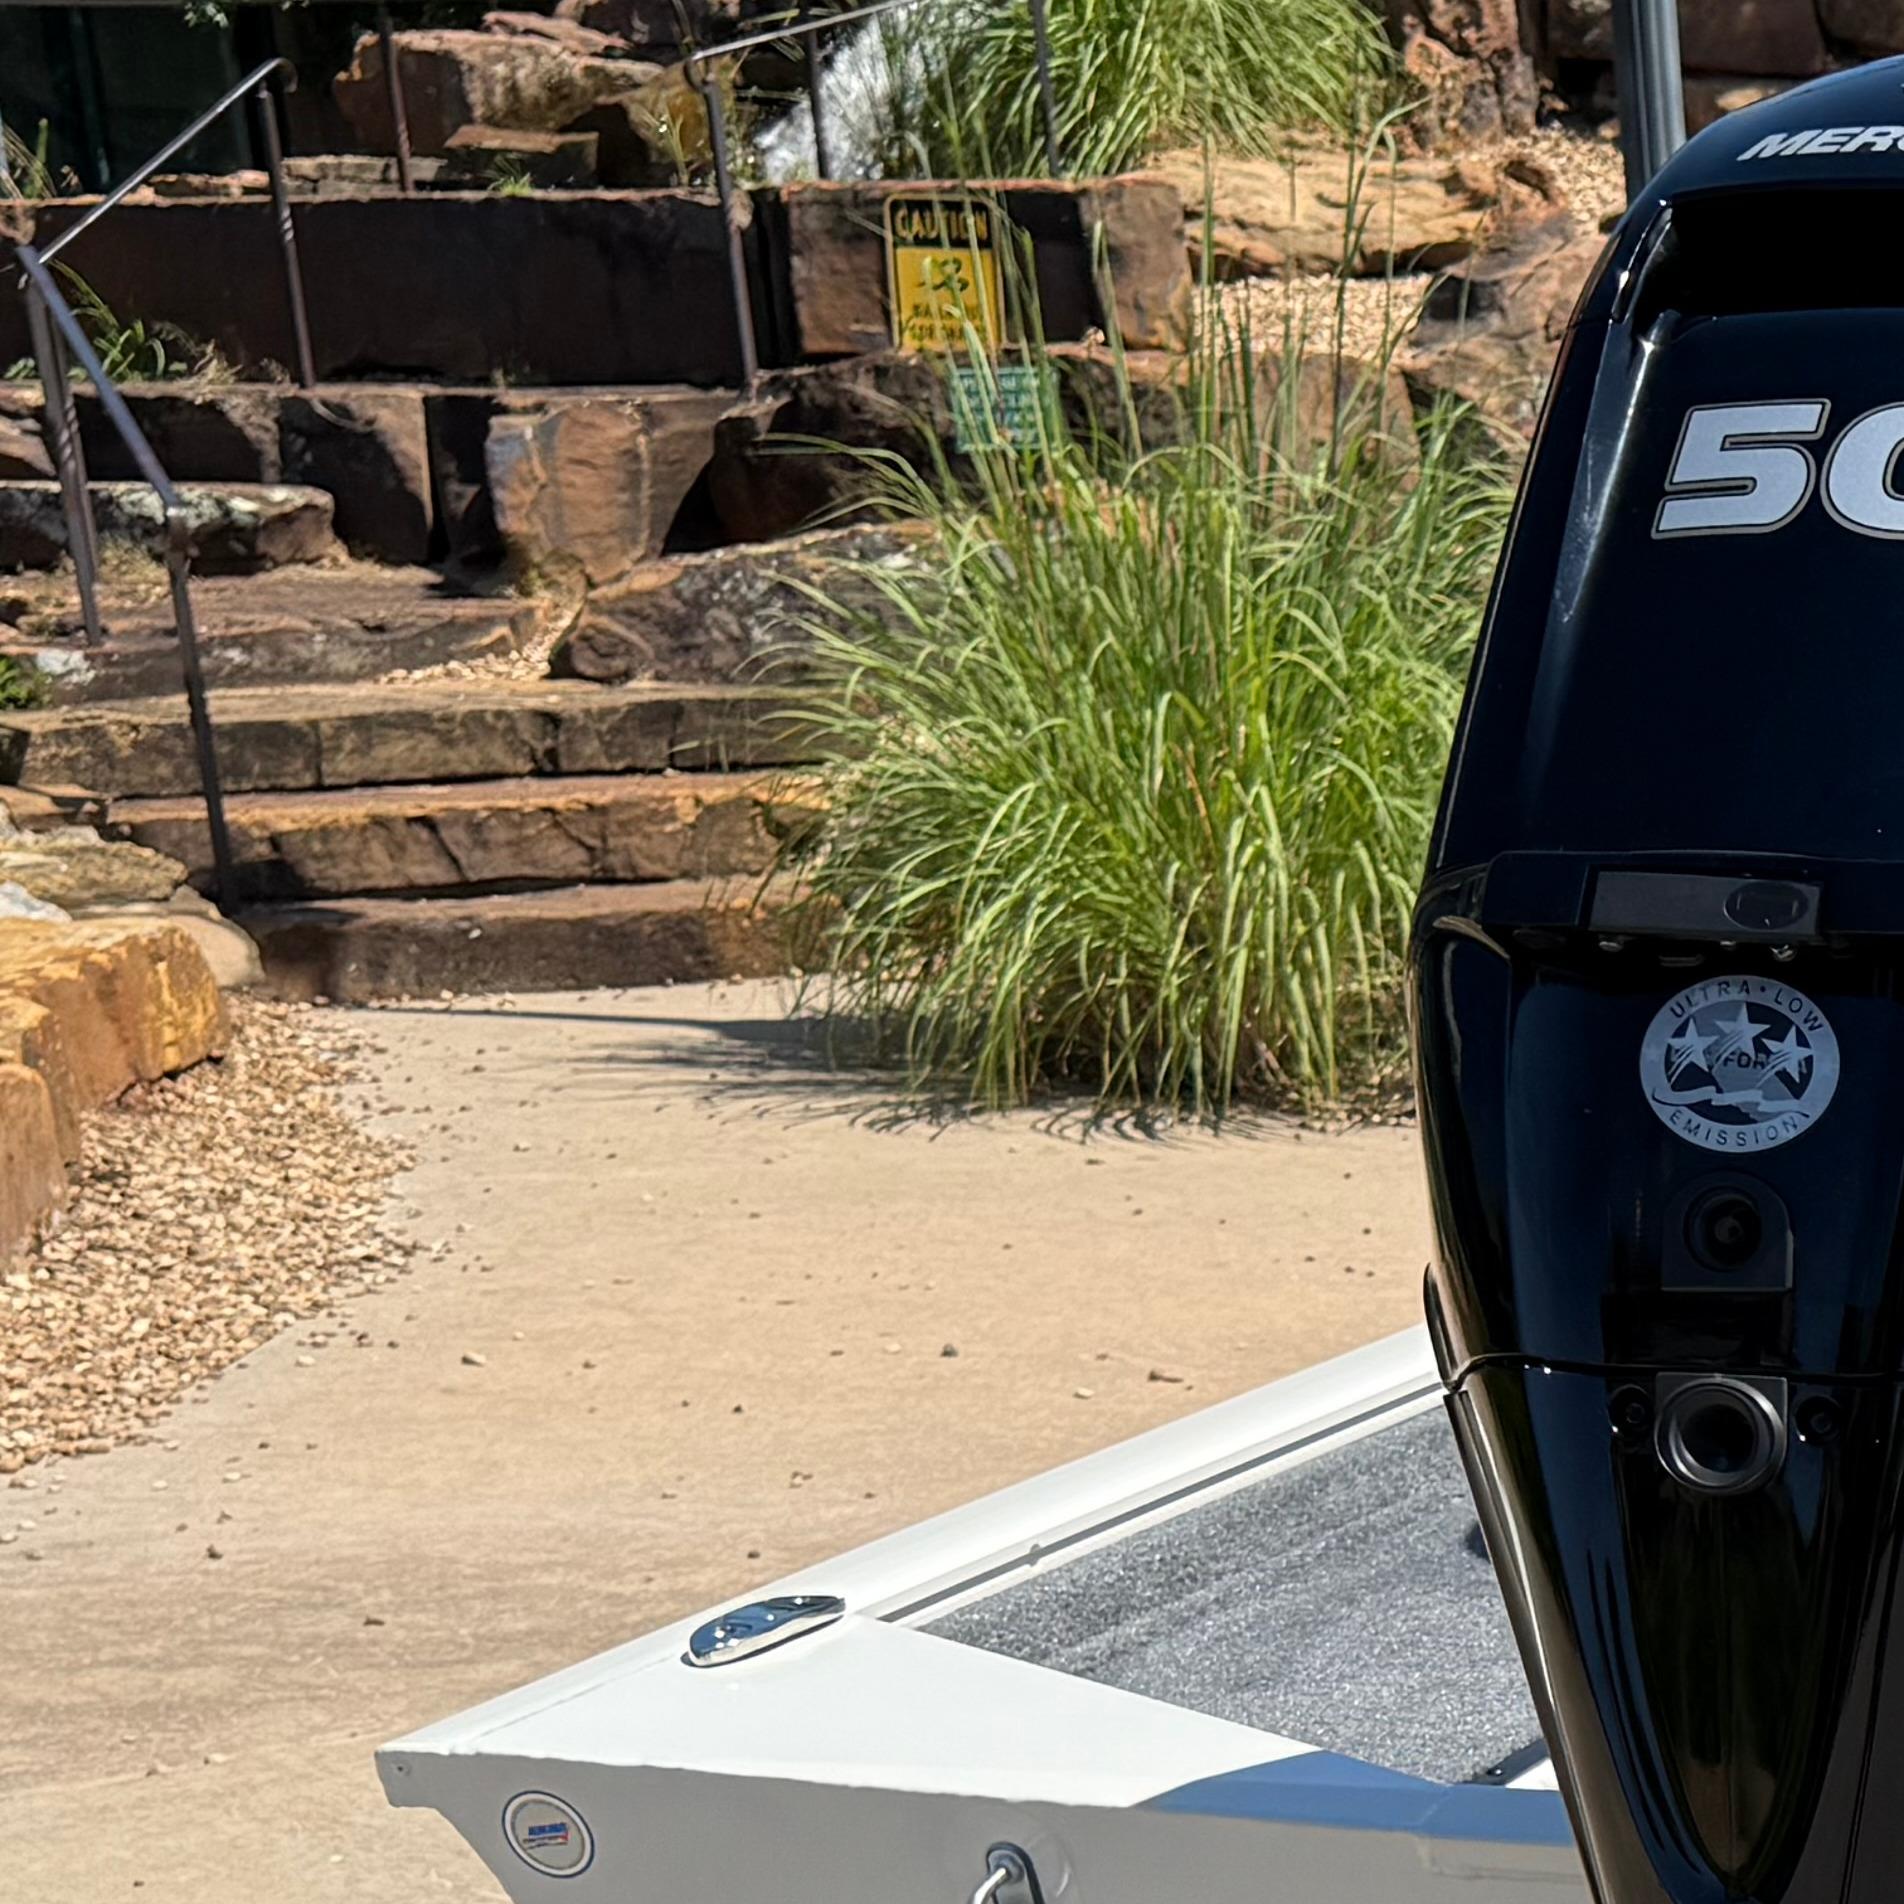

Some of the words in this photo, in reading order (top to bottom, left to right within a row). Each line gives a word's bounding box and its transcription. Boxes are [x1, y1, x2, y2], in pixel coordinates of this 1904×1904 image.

[1670, 979, 1750, 1019] ULTRA
[1774, 987, 1824, 1032] LOW
[1669, 1110, 1799, 1147] EMISSION
